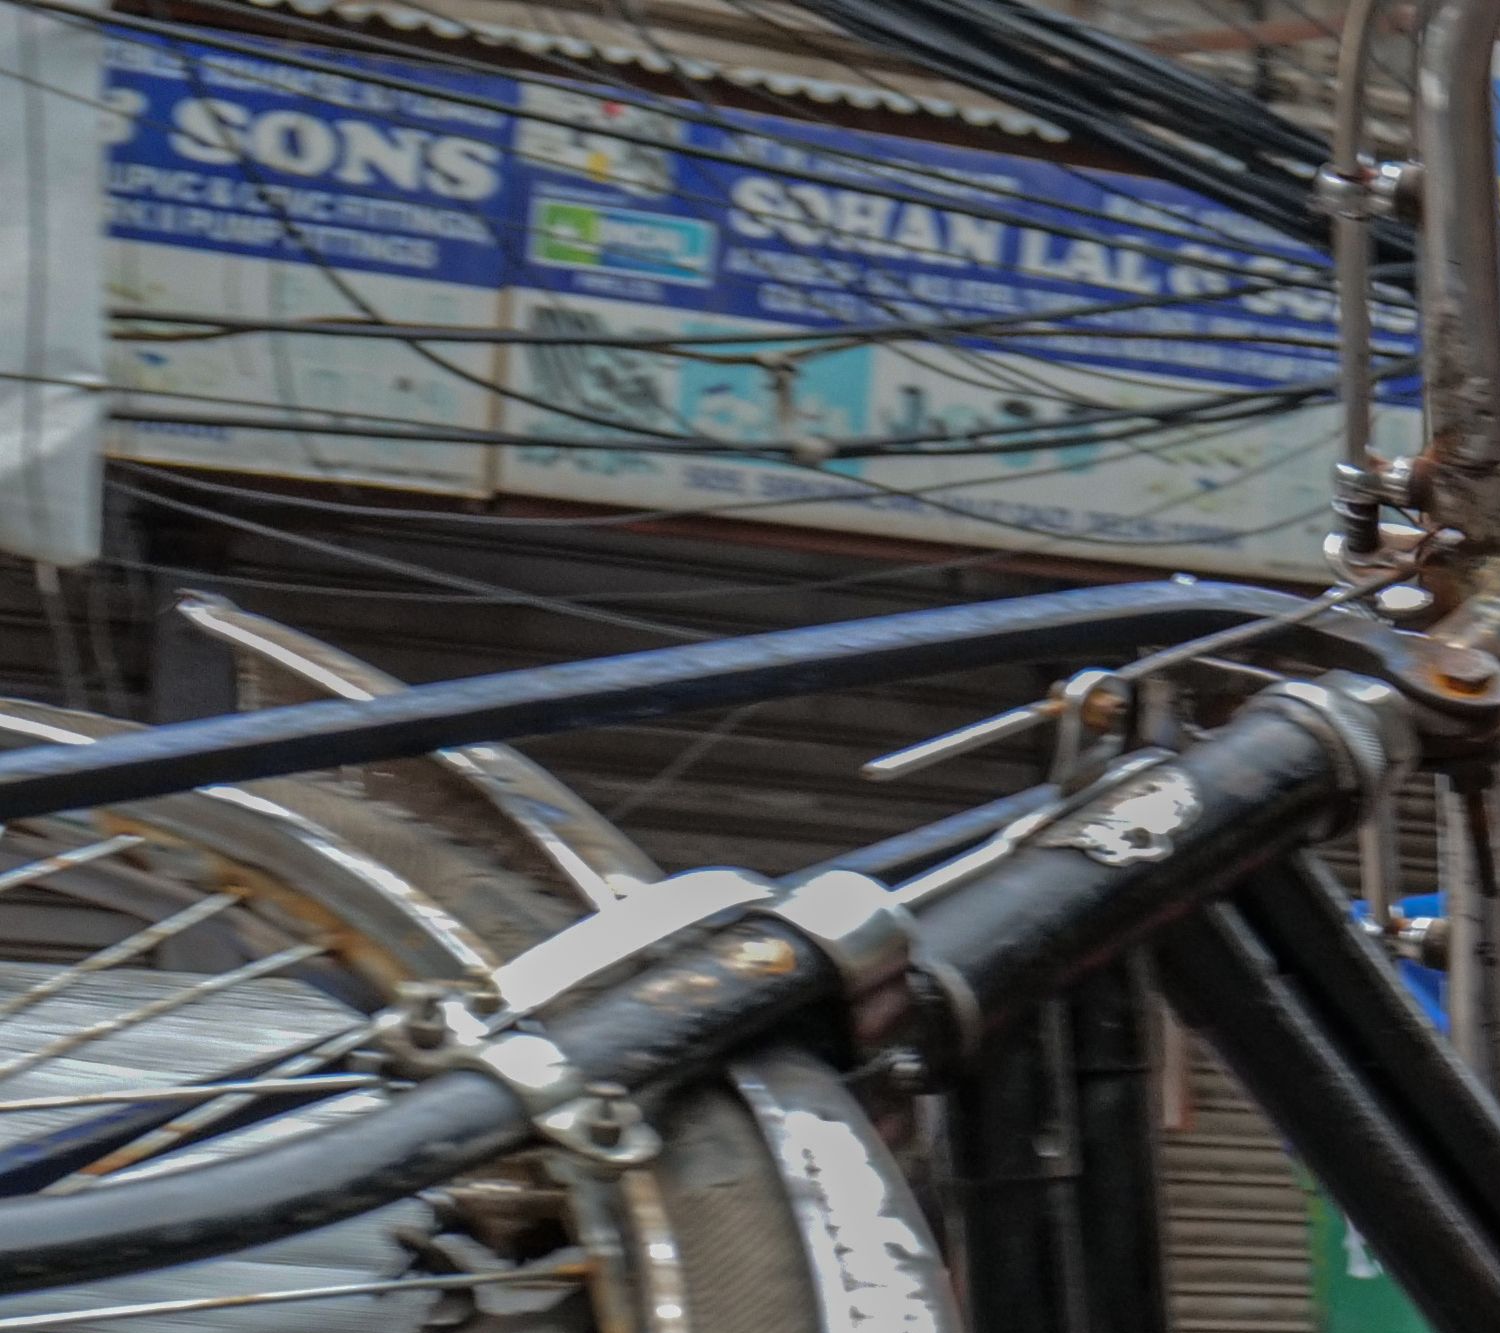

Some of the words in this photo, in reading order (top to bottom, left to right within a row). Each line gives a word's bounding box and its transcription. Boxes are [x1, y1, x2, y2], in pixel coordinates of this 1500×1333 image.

[169, 97, 499, 201] SONS
[729, 175, 1003, 264] SOHAN
[1019, 221, 1160, 294] LAL
